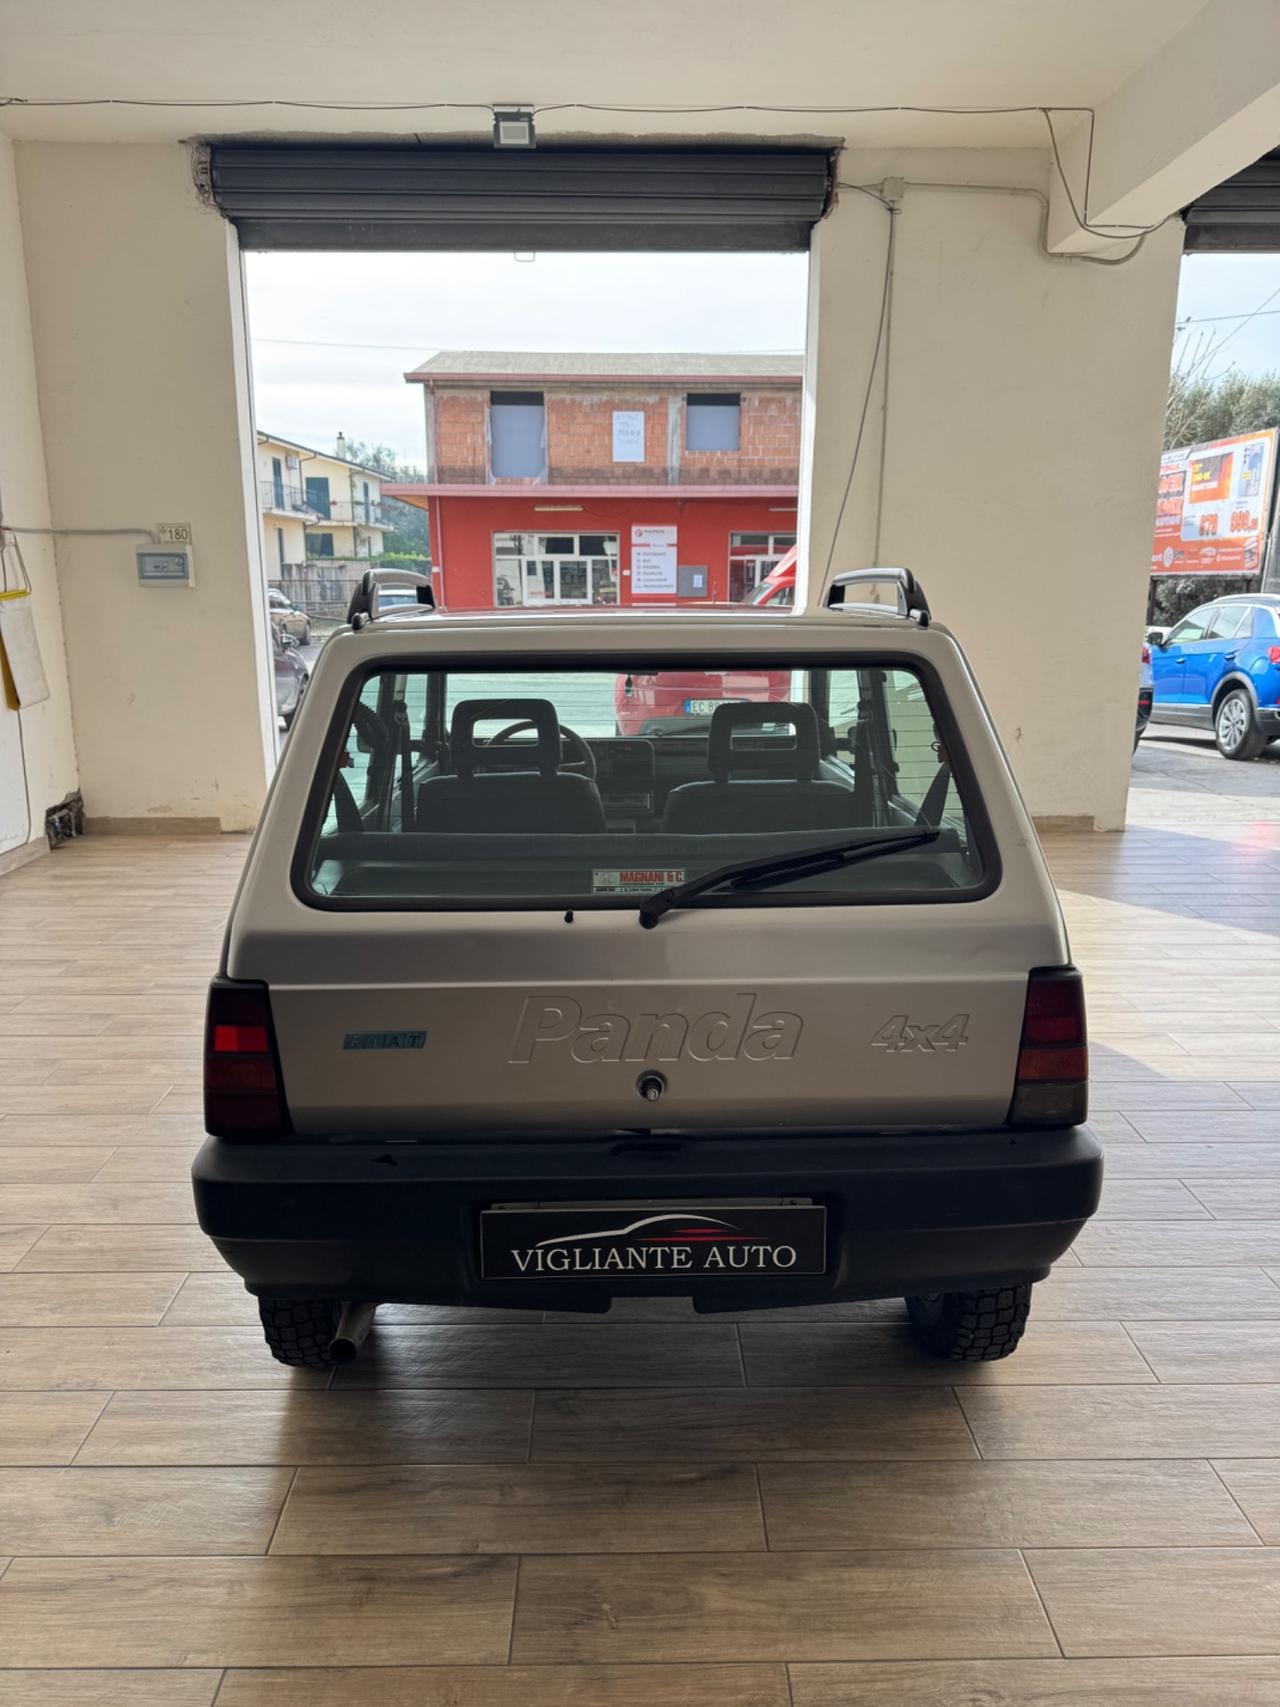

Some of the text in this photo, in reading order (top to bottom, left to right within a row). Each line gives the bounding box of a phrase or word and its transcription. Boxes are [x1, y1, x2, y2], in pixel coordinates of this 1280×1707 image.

[168, 528, 188, 540] 180
[620, 871, 664, 883] MAGNANI
[508, 993, 804, 1063] Panda
[870, 1014, 970, 1052] 4x4
[346, 1031, 425, 1050] FIAT
[511, 1245, 797, 1272] VIGLIANTE AUTO
